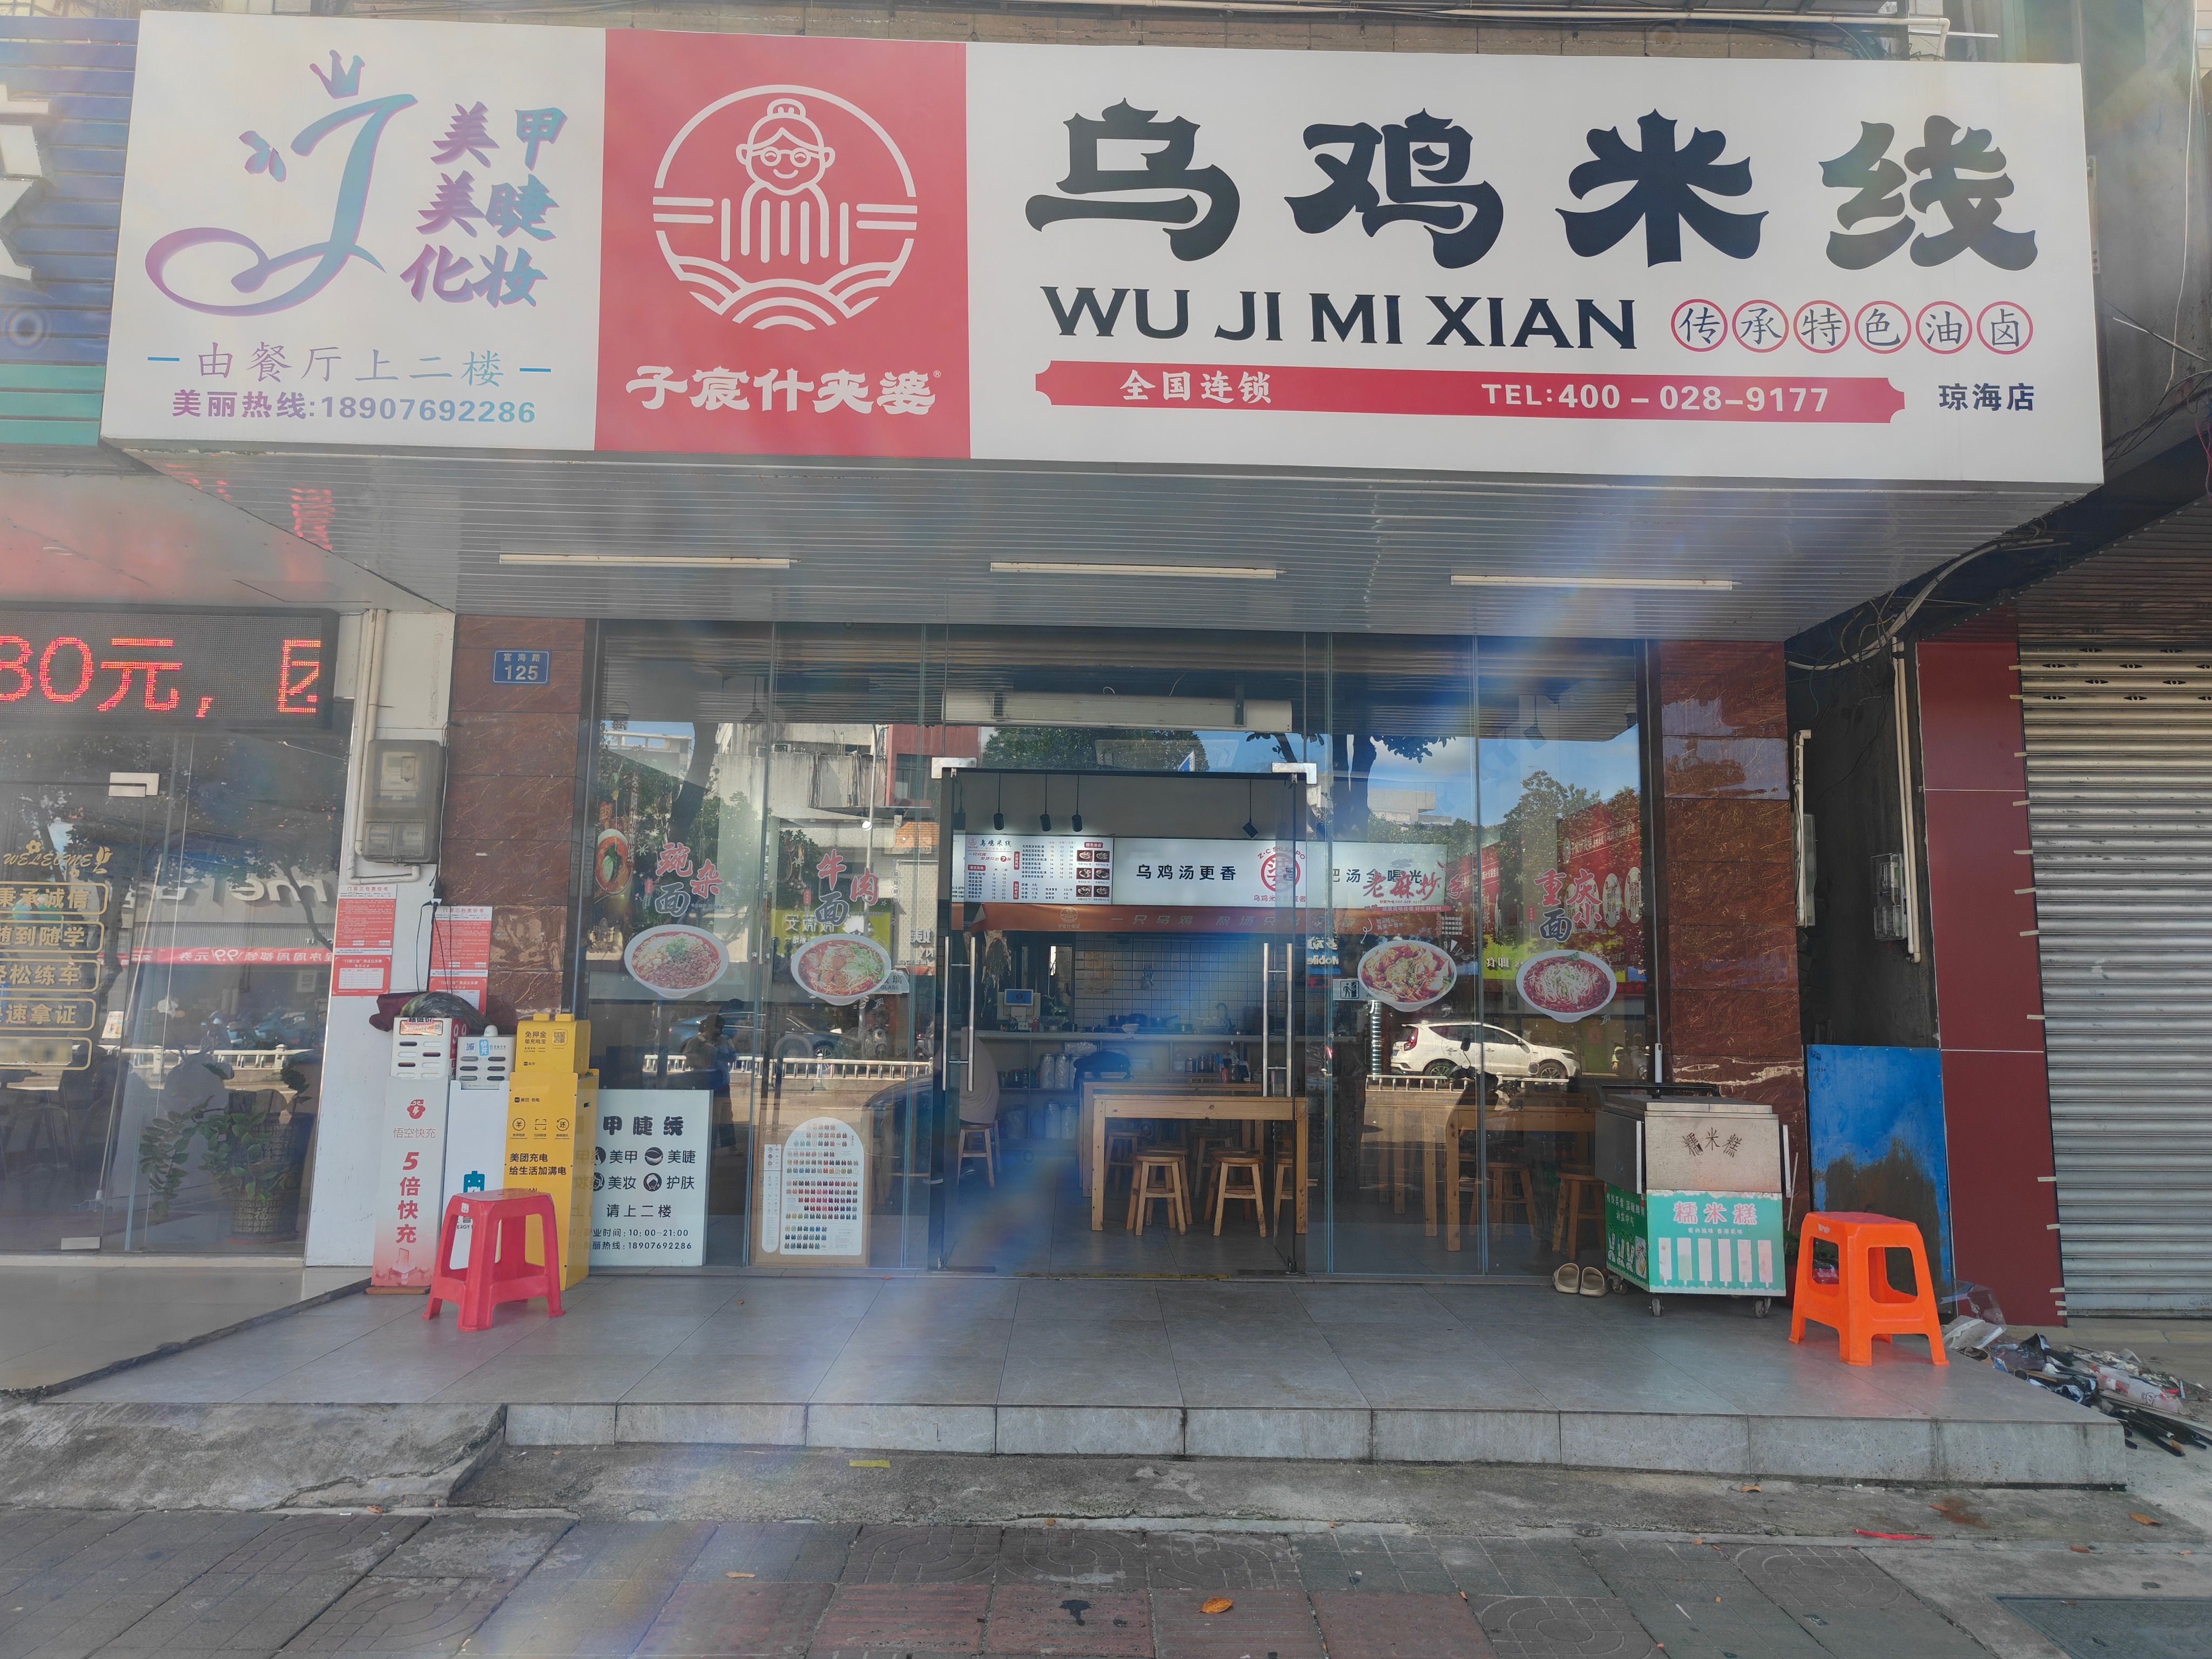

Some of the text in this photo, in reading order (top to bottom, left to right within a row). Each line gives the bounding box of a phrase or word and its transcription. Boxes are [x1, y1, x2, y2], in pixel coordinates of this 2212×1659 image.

[430, 100, 568, 170] 美甲
[1025, 97, 2037, 272] 乌鸡米线
[416, 171, 559, 241] 美睫
[399, 245, 548, 308] 化妆
[1040, 286, 1637, 350] WU JI MI XIAN
[1671, 299, 2034, 355] 传承特色油卤
[197, 342, 505, 389] 由餐厅上二楼
[1120, 369, 1272, 405] 全国连锁
[1939, 382, 2035, 412] 琼海店
[503, 652, 541, 662] 富海路
[504, 665, 539, 680] 125
[1136, 864, 1237, 881] 乌鸡汤更香
[0, 1003, 77, 1025] 速拿证
[393, 1127, 436, 1139] 悟空快充
[1682, 1127, 1742, 1157] 糯米糕
[509, 1153, 548, 1162] 美团充电
[609, 1149, 696, 1164] 美甲 美睫
[509, 1166, 567, 1176] 给生活加满电
[608, 1175, 695, 1190] 美妆 护肤
[606, 1204, 672, 1218] 请上二楼
[1673, 1201, 1758, 1225] 糯米糕
